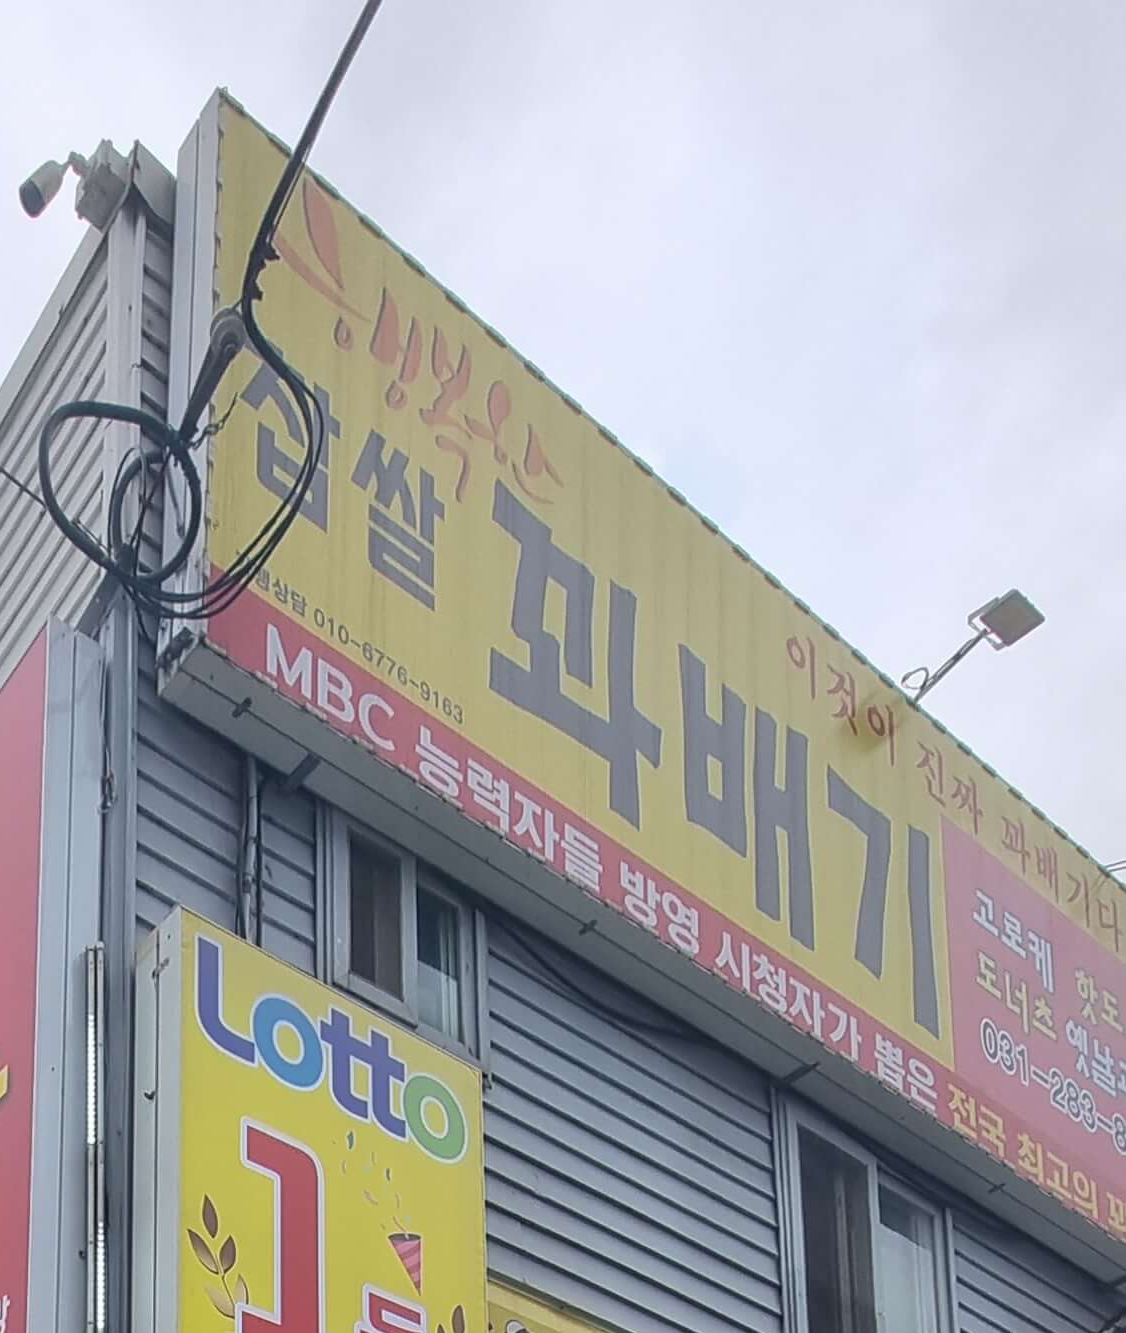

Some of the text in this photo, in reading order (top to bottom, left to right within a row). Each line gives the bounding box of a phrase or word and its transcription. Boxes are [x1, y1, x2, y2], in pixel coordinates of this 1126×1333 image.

[312, 606, 464, 726] 010-6776-9163
[489, 478, 950, 1044] 꽈배기
[265, 623, 396, 752] MBC
[413, 725, 604, 884] 능력자들
[619, 862, 702, 956] 방영
[715, 928, 863, 1064] 시청자가
[873, 1032, 940, 1118] 뽑은
[946, 1080, 1008, 1160] 전국
[1015, 1128, 1100, 1222] 최고의
[972, 886, 1056, 996] 고로케
[975, 948, 1058, 1042] 도너츠
[194, 932, 470, 1166] Lotto
